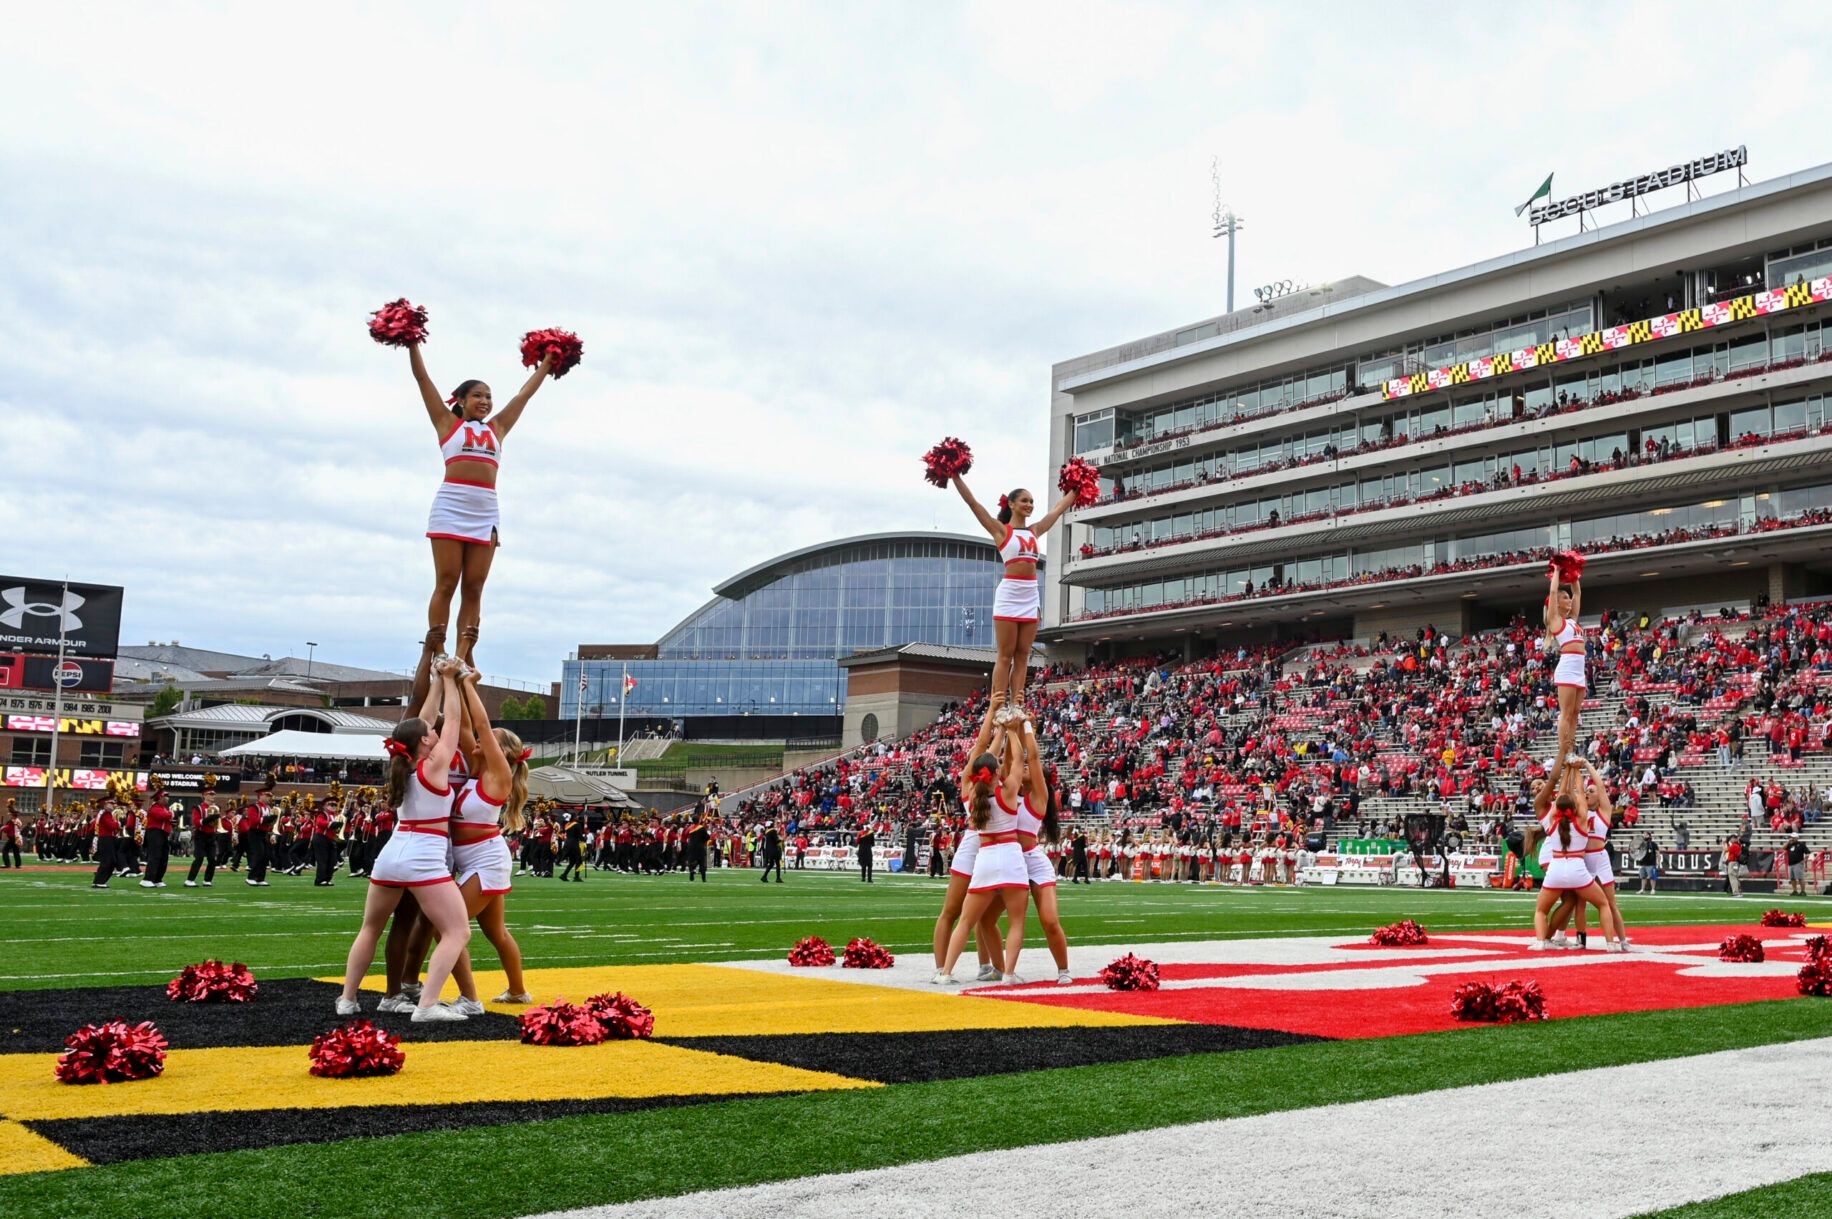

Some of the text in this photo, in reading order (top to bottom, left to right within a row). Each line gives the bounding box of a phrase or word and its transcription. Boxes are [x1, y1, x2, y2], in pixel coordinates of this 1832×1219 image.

[1601, 145, 1747, 202] STADIUM
[463, 426, 496, 452] M
[1103, 451, 1128, 463] NATIONAL
[1131, 442, 1172, 458] CHAMPIONSHIP
[1175, 437, 1190, 448] 1953
[1015, 535, 1039, 554] M
[0, 634, 87, 648] NDER ARMOUR
[10, 699, 25, 709] 1975
[28, 700, 43, 710] 1976
[63, 702, 78, 711] 1984
[81, 704, 95, 713] 1985
[97, 704, 112, 714] 2001
[1621, 853, 1712, 870] GLRIOUS
